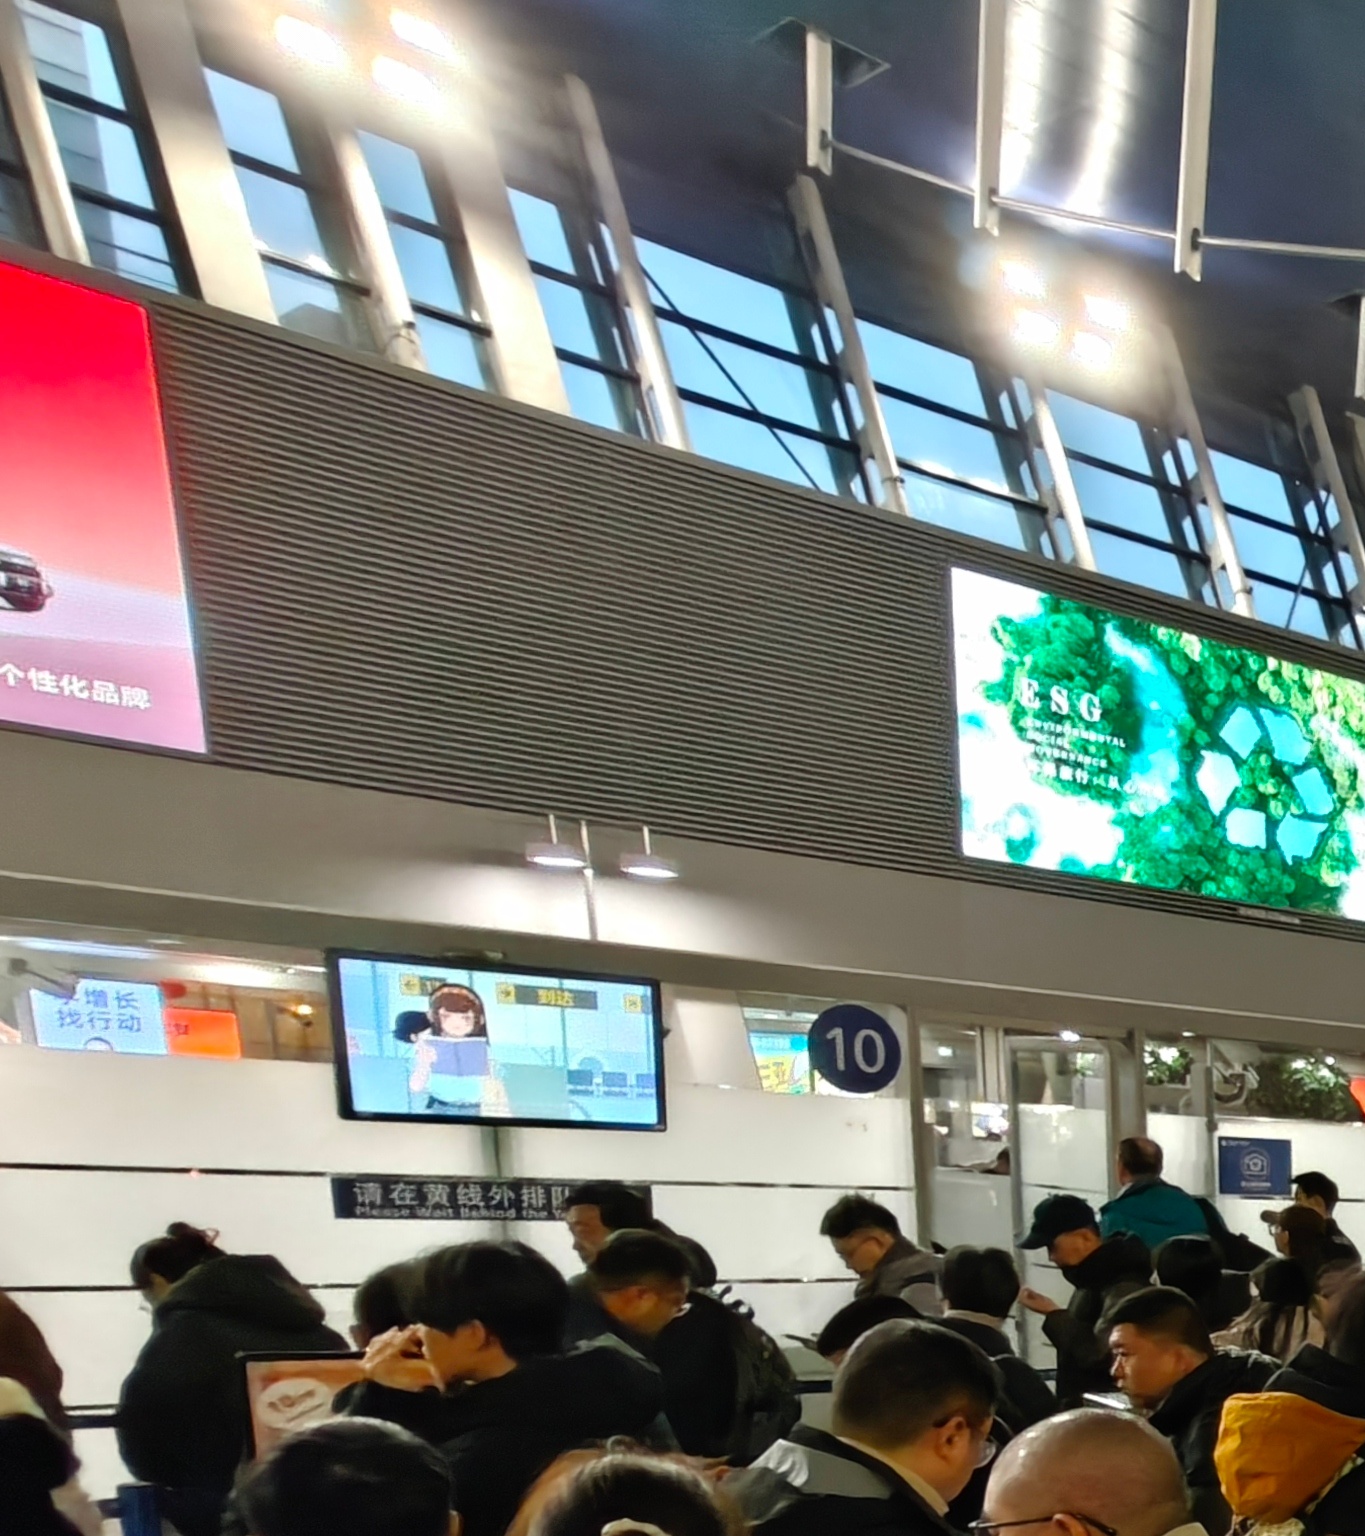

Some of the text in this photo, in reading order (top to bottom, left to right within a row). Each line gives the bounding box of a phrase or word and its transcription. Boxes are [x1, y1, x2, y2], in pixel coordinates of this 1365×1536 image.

[0, 662, 151, 710] 个性化品牌
[826, 1027, 886, 1073] 10
